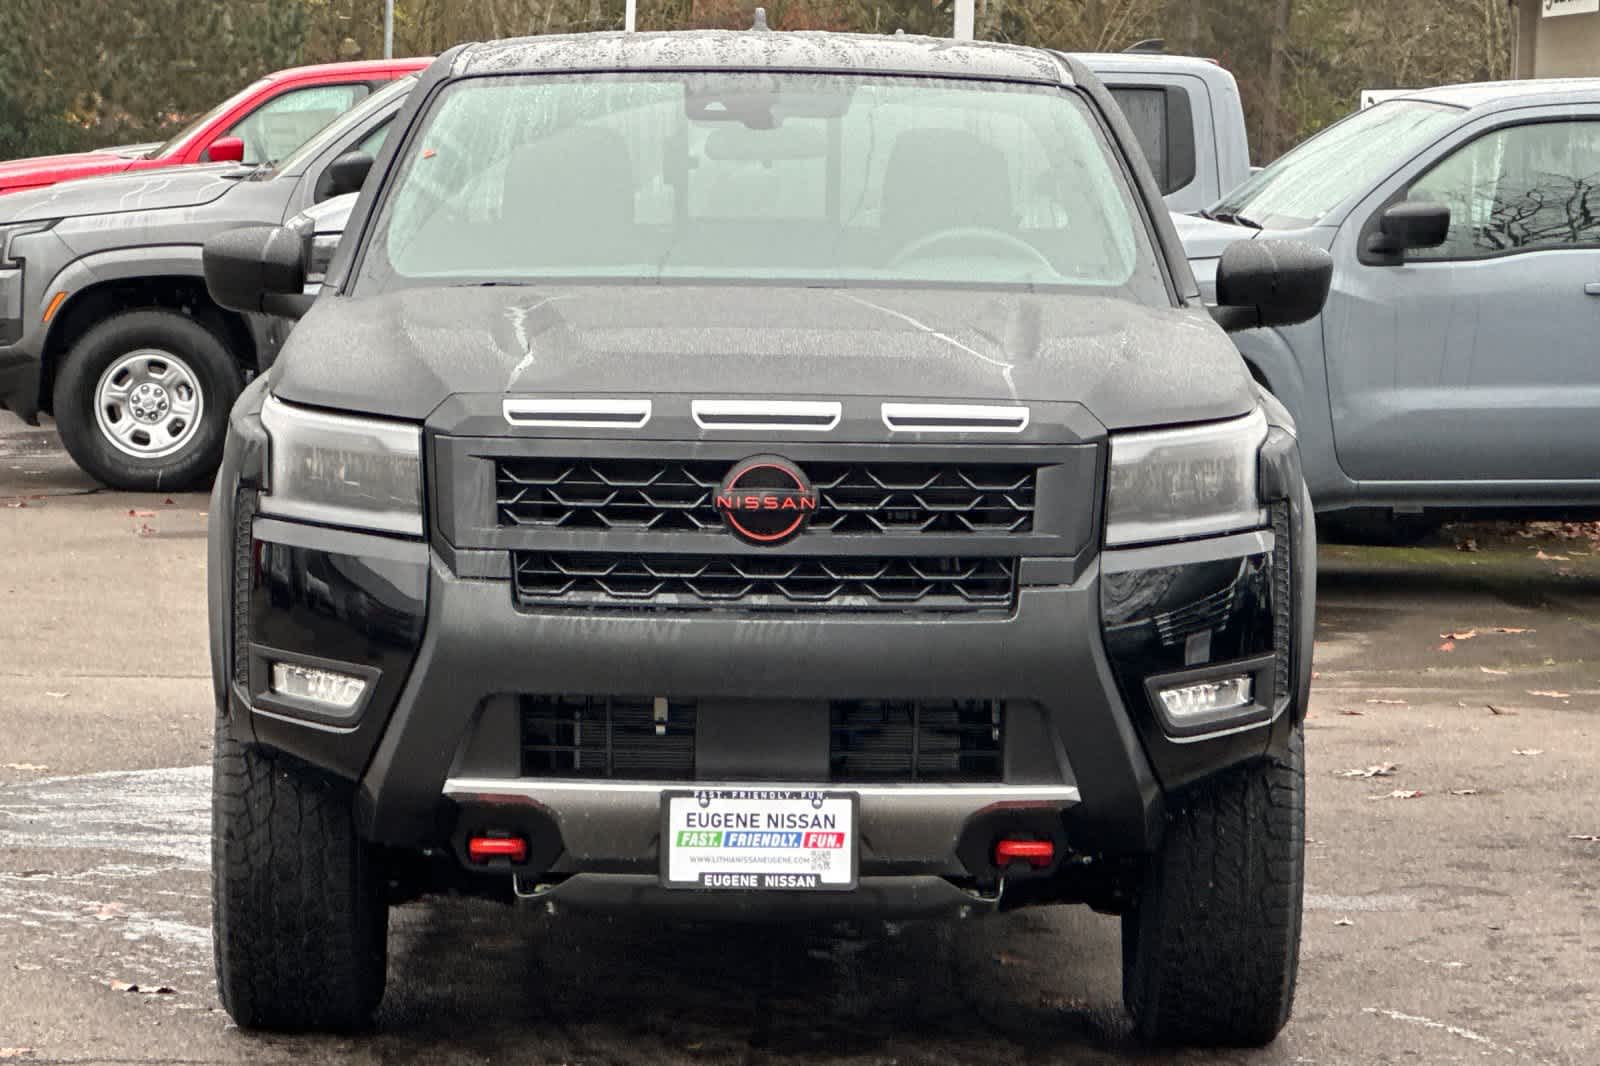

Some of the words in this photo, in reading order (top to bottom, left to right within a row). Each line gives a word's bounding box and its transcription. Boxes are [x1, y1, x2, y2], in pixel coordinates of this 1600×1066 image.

[716, 495, 817, 510] NISSAN
[732, 791, 797, 800] FRIENDLY.
[686, 812, 760, 828] EUGENE
[767, 813, 836, 829] NISSAN
[682, 833, 719, 847] FAST.
[728, 833, 799, 847] FRIENDLY.
[808, 833, 841, 848] FUN.
[704, 874, 758, 887] EUGENE
[765, 875, 816, 888] NISSAN
